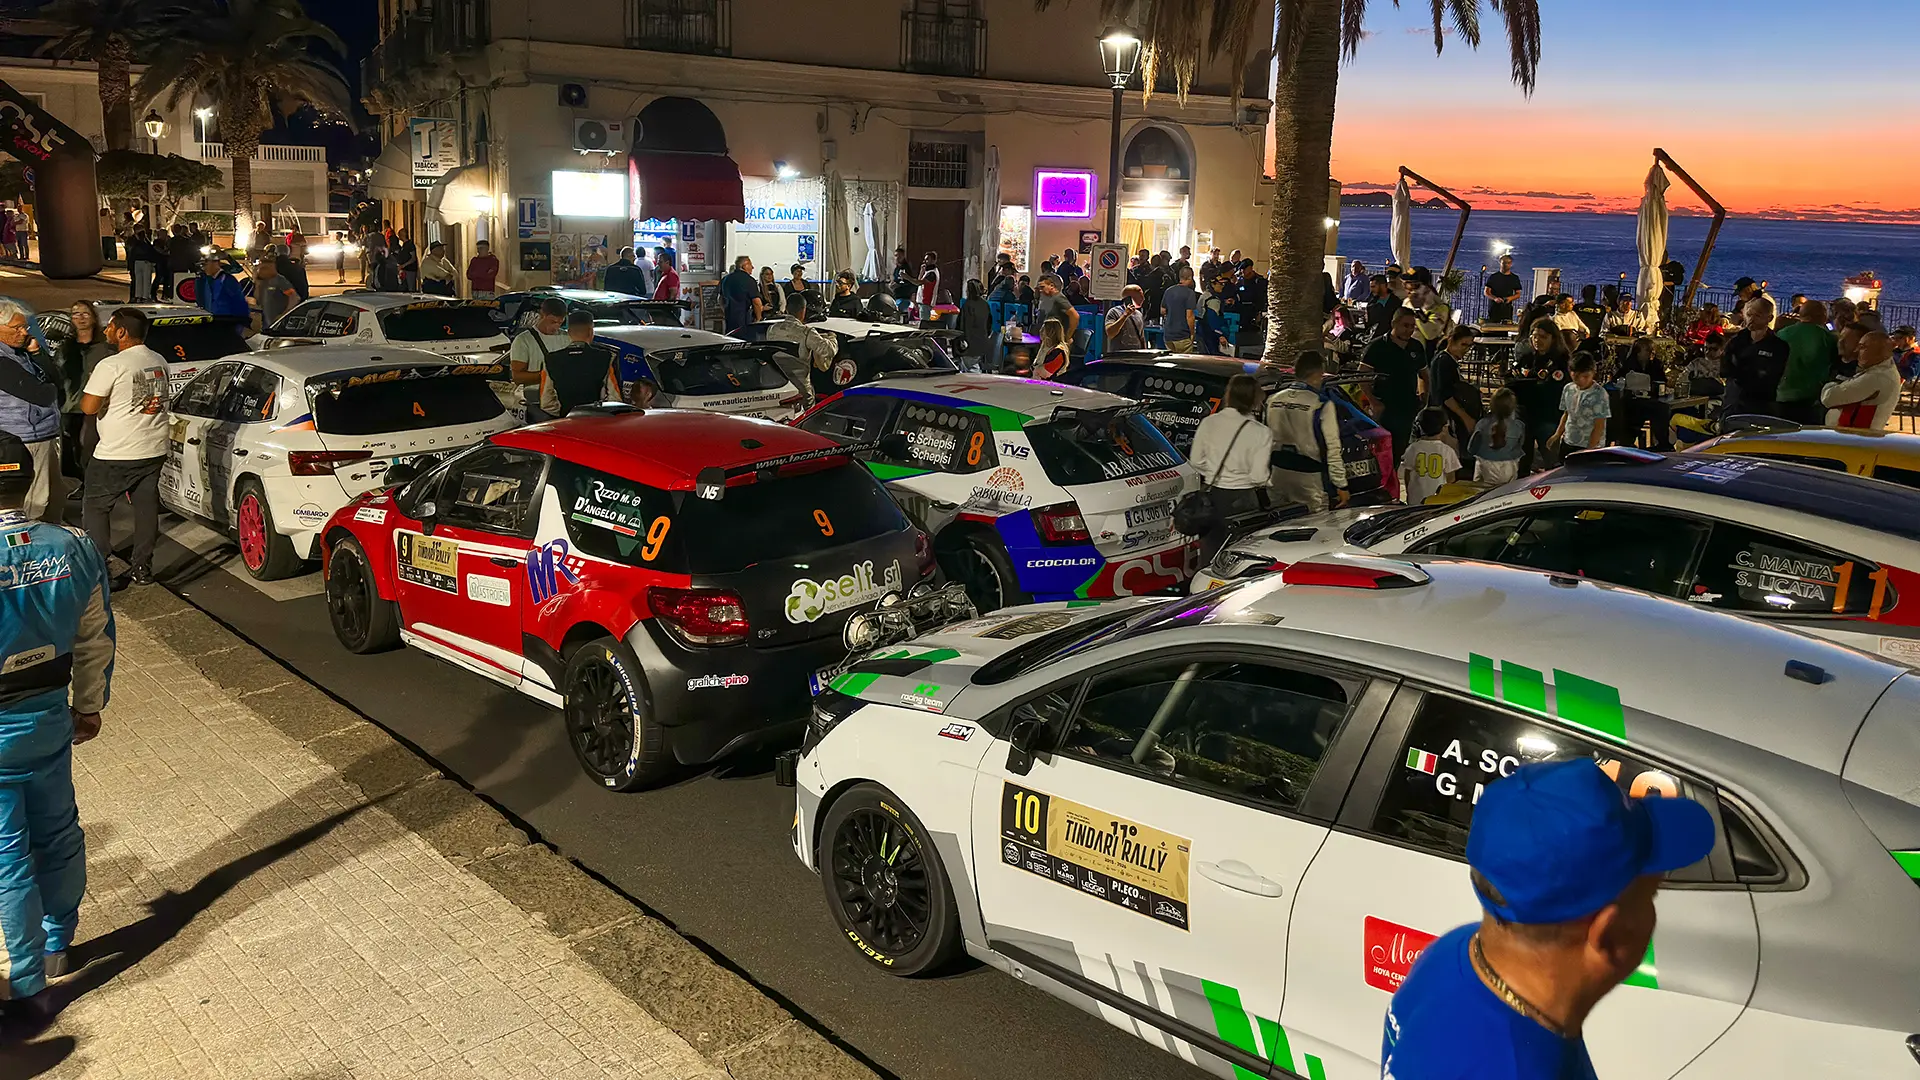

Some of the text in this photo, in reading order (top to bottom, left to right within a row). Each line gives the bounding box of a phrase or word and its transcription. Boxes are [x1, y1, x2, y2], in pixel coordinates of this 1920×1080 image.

[414, 121, 436, 158] T
[443, 325, 455, 335] 2
[173, 344, 186, 358] 3
[260, 391, 276, 420] 4
[703, 393, 781, 407] www.nauticatrimarchi.it
[1209, 397, 1222, 415] 7
[413, 402, 425, 417] 4
[1155, 411, 1200, 426] Siragusano
[912, 447, 952, 465] Schepisi
[967, 431, 985, 465] 8
[1002, 443, 1031, 458] TVS
[1415, 452, 1443, 479] 40
[593, 480, 630, 504] RIZZO M.
[701, 485, 720, 500] N5
[293, 509, 329, 517] LOMBARDO
[574, 496, 627, 523] D'ANGELO M.
[1133, 507, 1145, 524] GJ
[1146, 506, 1160, 521] 306
[812, 508, 835, 537] 9
[401, 535, 408, 557] 9
[641, 515, 671, 562] 9
[22, 554, 66, 572] TEAM
[1026, 557, 1096, 568] ECOCOLOR
[1735, 551, 1834, 582] C. MANTA
[20, 563, 71, 585] ITALIA
[1735, 571, 1826, 602] S. LICATA
[1832, 561, 1888, 620] 11
[615, 662, 639, 711] MICHELIN
[687, 674, 749, 691] grafichepino
[900, 693, 943, 707] racing team
[942, 724, 975, 741] JEM
[1441, 739, 1471, 766] A.
[1435, 772, 1463, 800] G.
[1013, 791, 1041, 835] 10
[1064, 819, 1168, 874] TINDARI RALLY
[1033, 862, 1051, 874] BETA
[1081, 880, 1105, 894] LEGGIO
[1112, 880, 1139, 899] PI.ECO
[1373, 965, 1391, 978] HOYA
